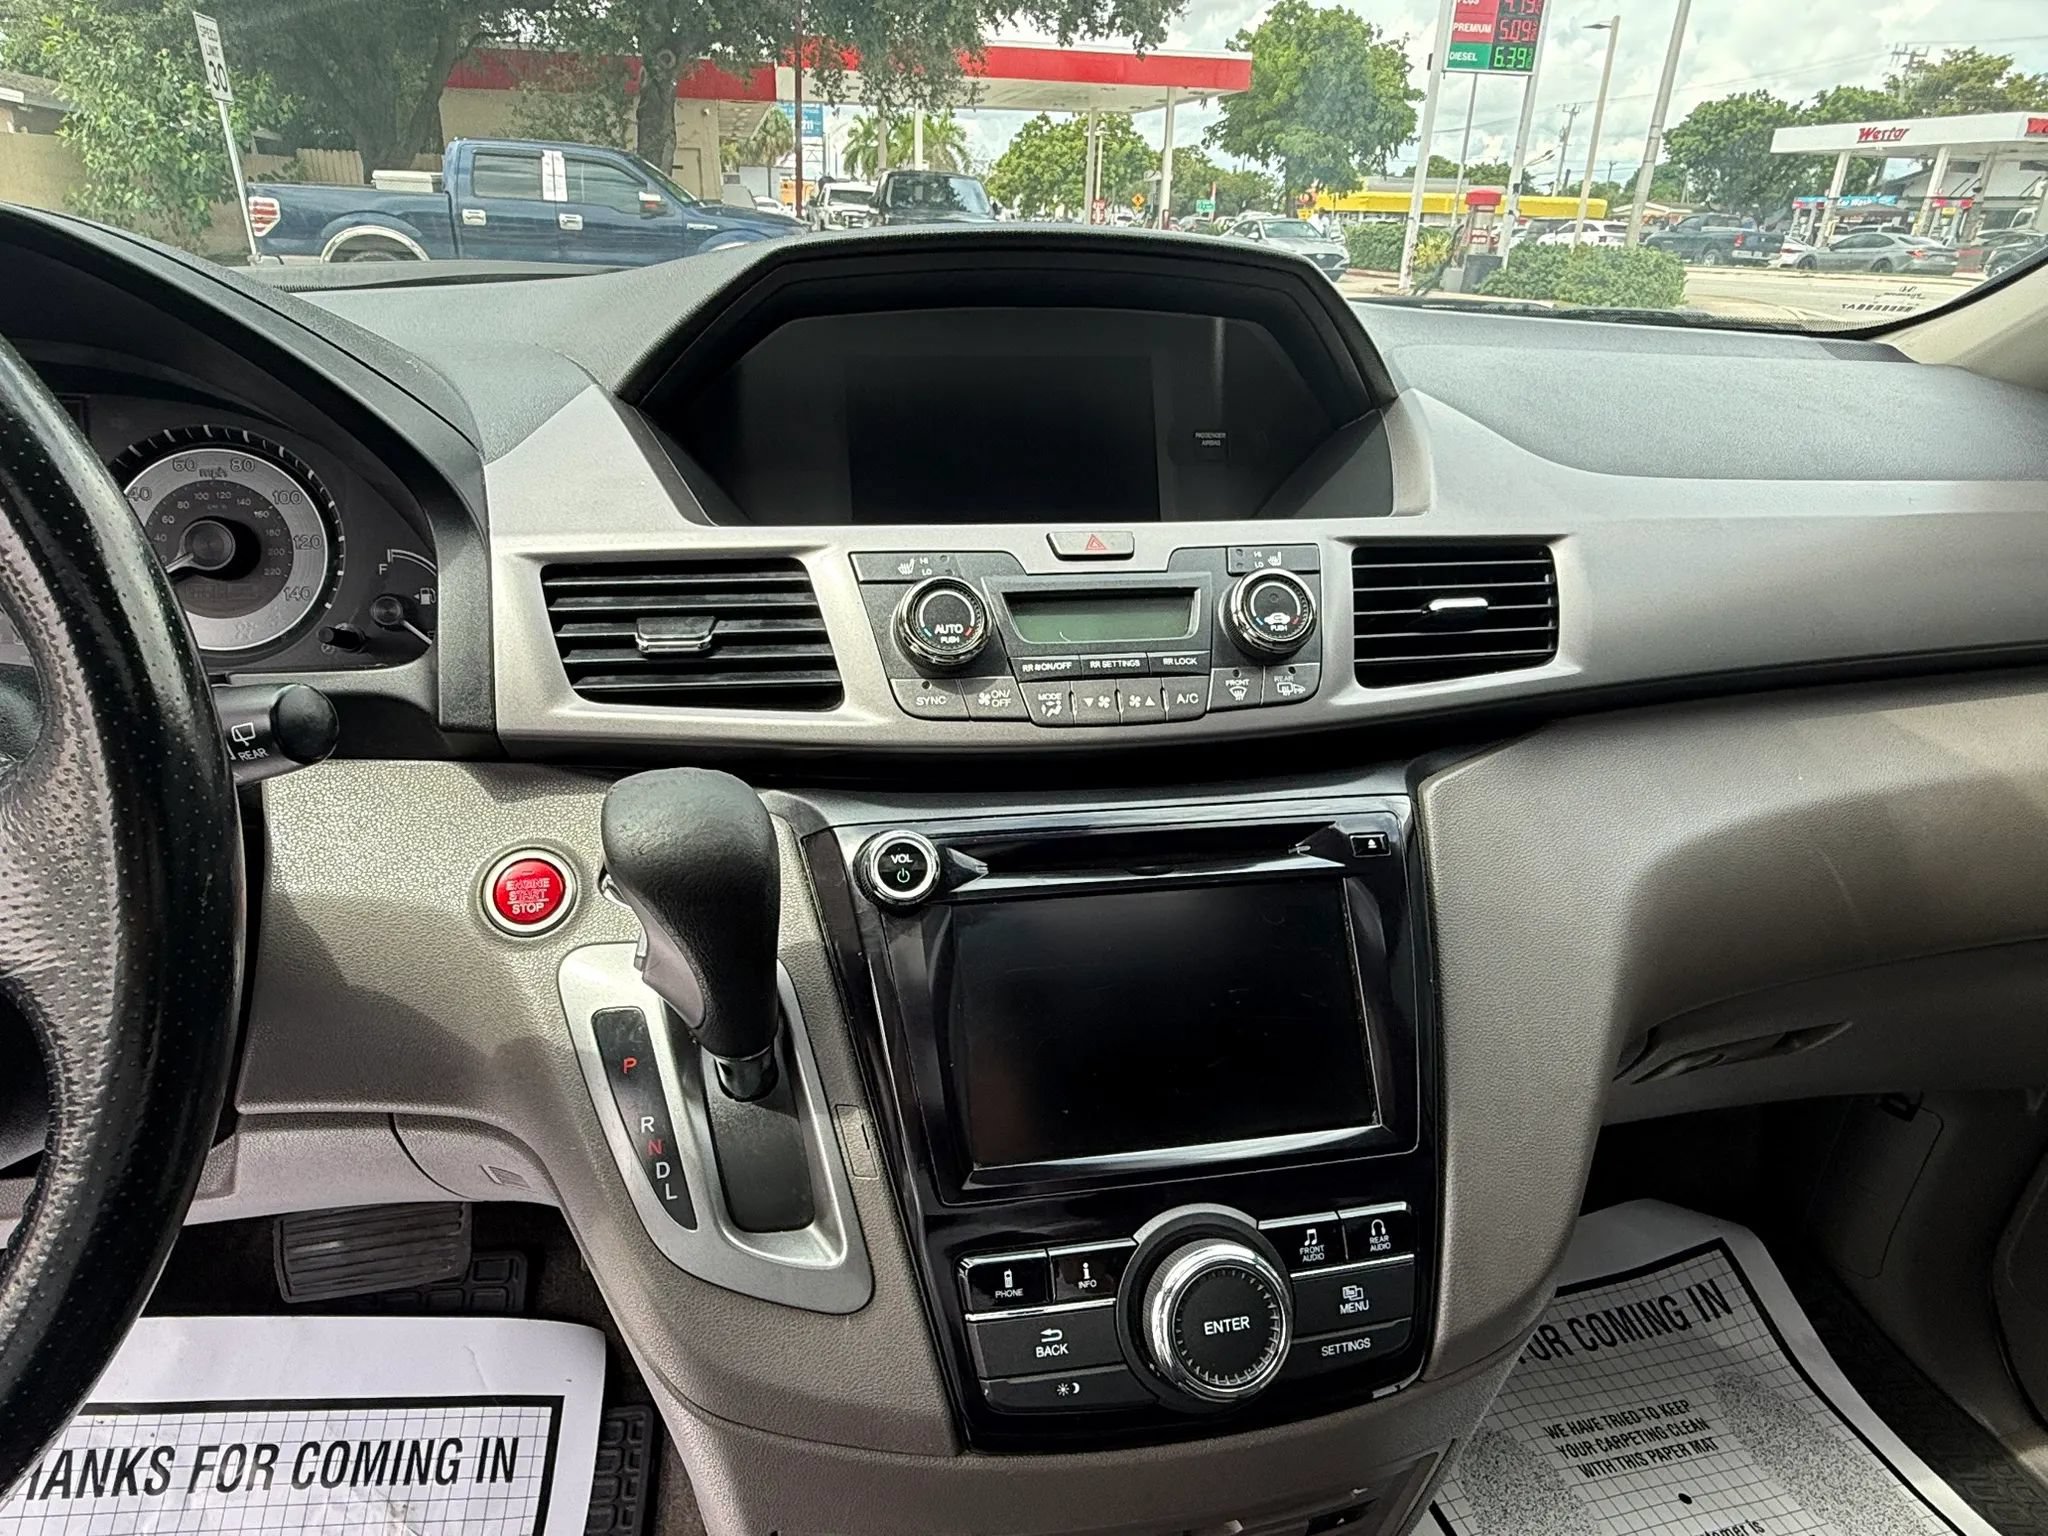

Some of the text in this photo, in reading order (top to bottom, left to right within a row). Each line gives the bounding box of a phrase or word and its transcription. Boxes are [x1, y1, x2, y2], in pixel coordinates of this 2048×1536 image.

[1453, 22, 1492, 33] PREMIUM
[1449, 51, 1478, 61] DIESEL
[208, 60, 228, 93] 30
[172, 458, 197, 473] 60
[230, 458, 255, 473] 80
[216, 491, 232, 500] 120
[272, 490, 302, 505] 100
[177, 500, 190, 510] 80
[161, 515, 175, 525] 60
[293, 534, 321, 551] 120
[919, 557, 929, 565] HI
[1254, 561, 1265, 569] LO
[264, 567, 282, 576] 220
[379, 563, 389, 576] F
[921, 567, 933, 576] LO
[284, 586, 311, 602] 140
[934, 623, 964, 635] AUTO
[1270, 624, 1288, 632] PUSH
[940, 636, 960, 644] PUSH
[1022, 661, 1073, 672] RR ON/OFF
[1089, 659, 1141, 668] RR SETTINGS
[1162, 657, 1198, 666] RR LOCK
[1225, 678, 1250, 687] FRONT
[916, 696, 947, 706] SYNC
[1038, 692, 1063, 700] MODE
[1176, 692, 1199, 705] A/C
[991, 698, 1012, 708] OFF
[238, 747, 270, 761] REAR
[890, 853, 914, 864] VOL
[505, 877, 551, 891] ENGINE
[508, 888, 548, 901] START
[511, 902, 545, 915] STOP
[623, 1057, 638, 1074] P
[641, 1116, 655, 1133] R
[647, 1138, 663, 1156] N
[656, 1161, 671, 1179] D
[665, 1183, 678, 1201] L
[1369, 1234, 1390, 1244] REAR
[1299, 1244, 1325, 1256] FRONT
[1369, 1241, 1391, 1252] AUDIO
[1302, 1252, 1325, 1262] AUDIO
[1078, 1279, 1097, 1289] INFO
[995, 1288, 1024, 1299] PHONE
[1339, 1299, 1370, 1315] MENU
[1203, 1315, 1251, 1335] ENTER
[1518, 1278, 1733, 1364] OR COMING IN
[1035, 1343, 1069, 1358] BACK
[1321, 1337, 1372, 1357] SETTINGS
[1543, 1399, 1691, 1440] WE HAVE TRIED TO KEEP
[1555, 1416, 1711, 1460] YOUR CARPETING CLEAN
[1577, 1436, 1720, 1479] WITH THIS PAPER MAT
[188, 1443, 280, 1495] FOR
[291, 1436, 464, 1490] COMING
[475, 1436, 519, 1484] IN
[1744, 1519, 1765, 1534] is
